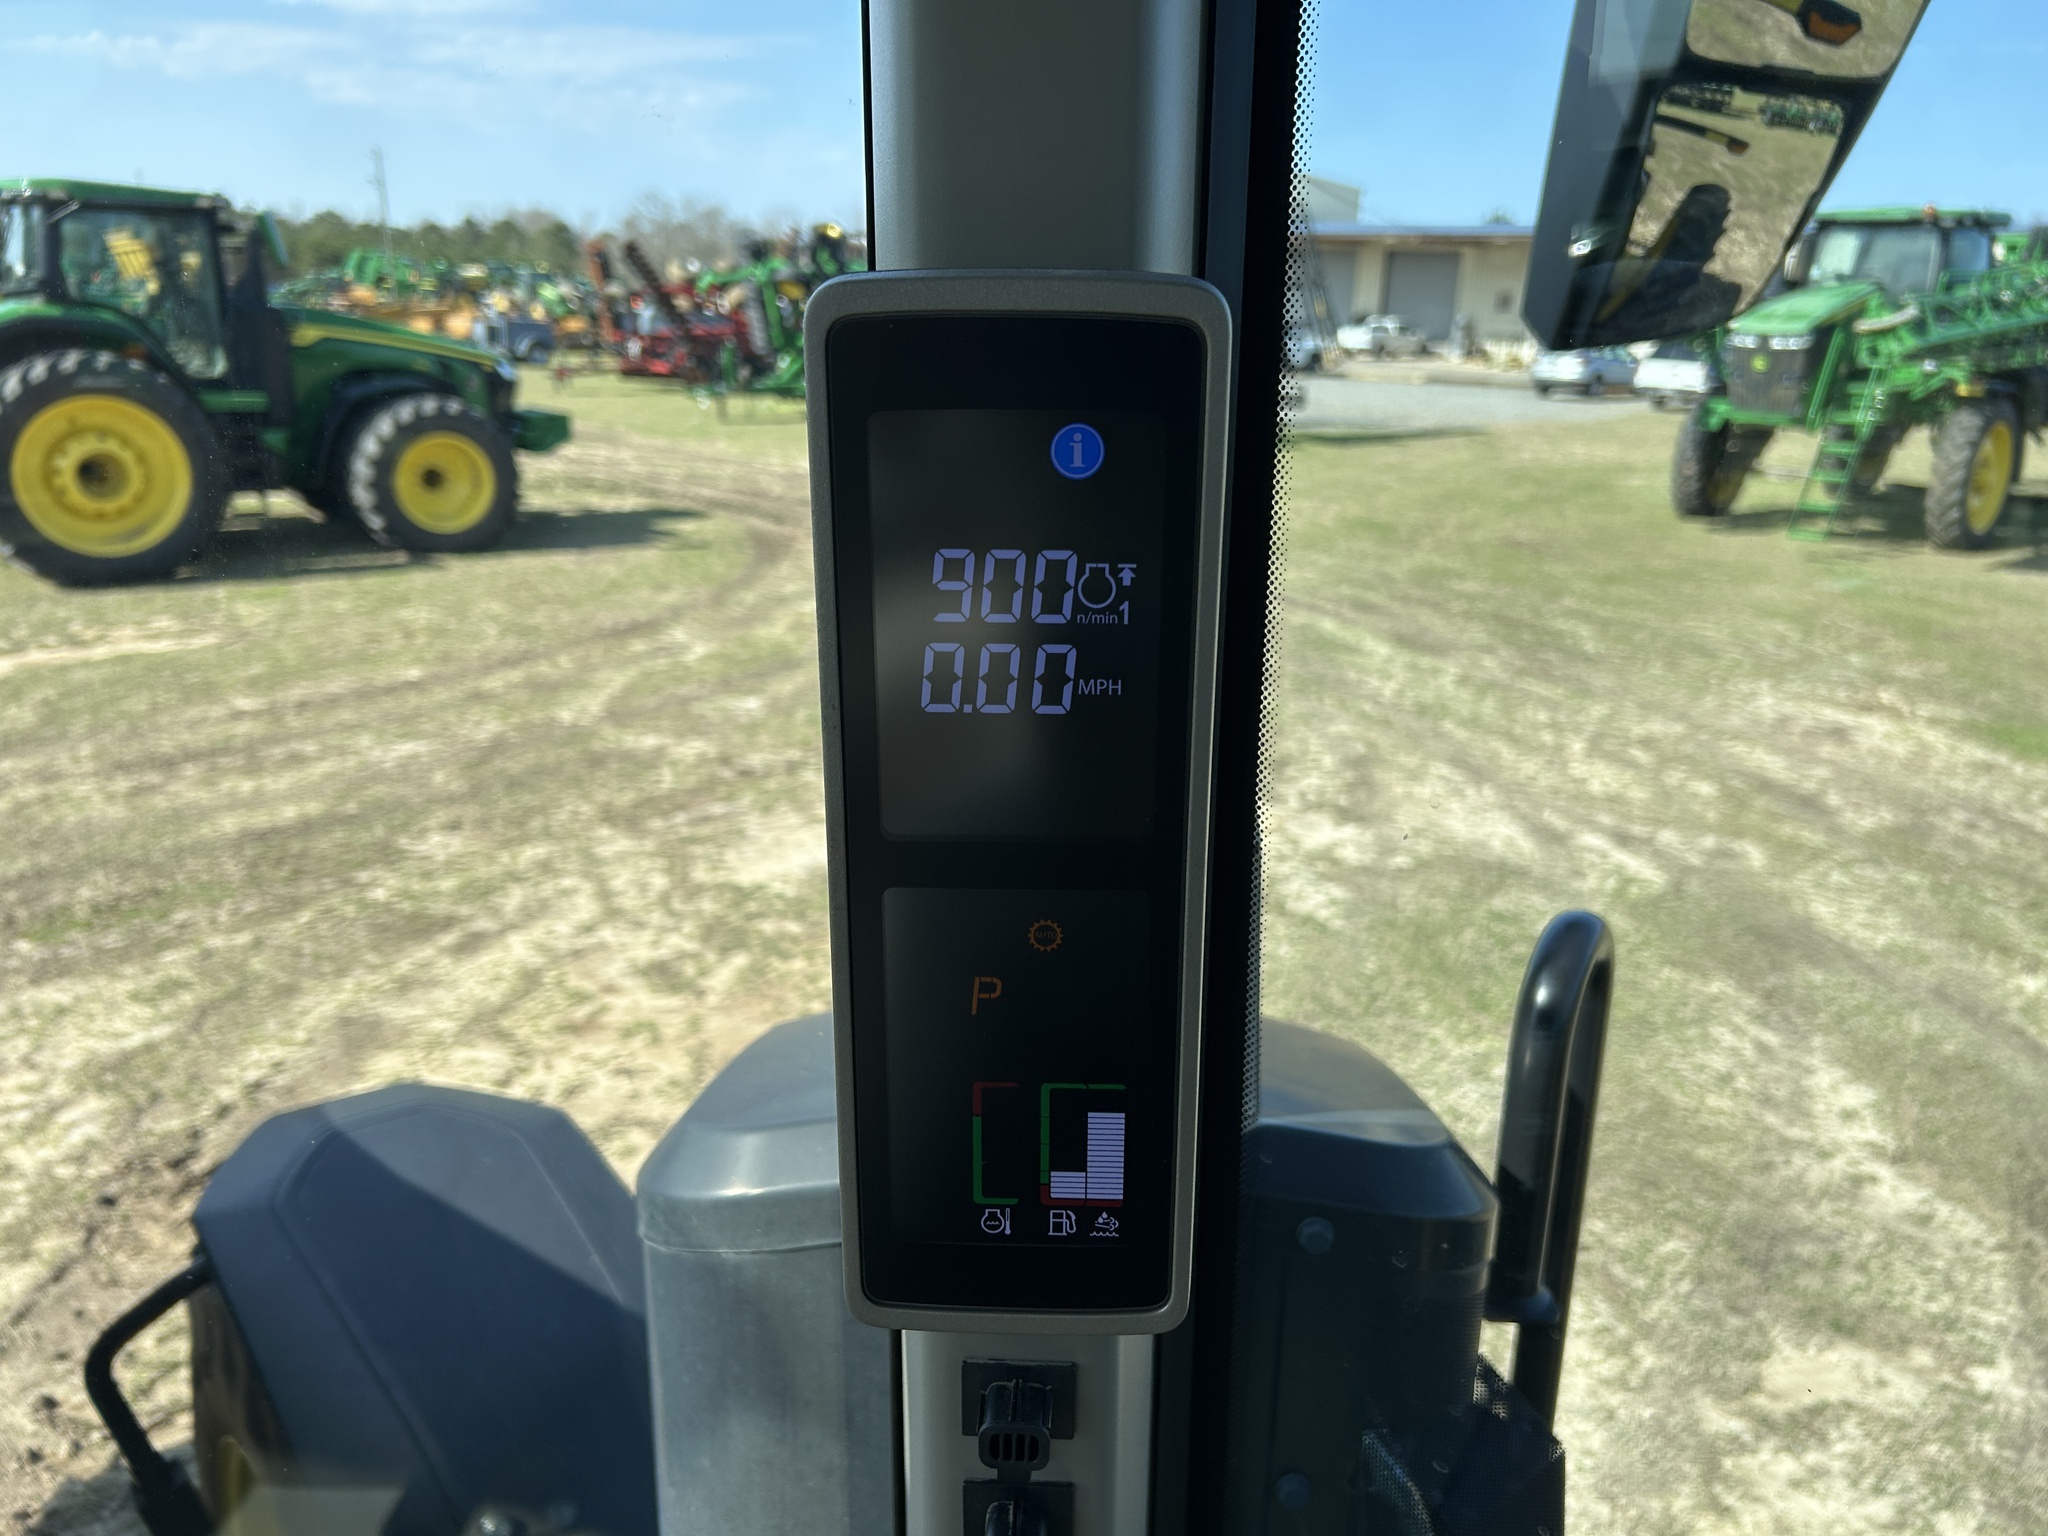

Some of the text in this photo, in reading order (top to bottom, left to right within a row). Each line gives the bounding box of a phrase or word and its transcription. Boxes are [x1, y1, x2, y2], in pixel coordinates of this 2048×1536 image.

[932, 548, 1130, 625] 900 n/min 1
[921, 642, 1122, 714] 0.00 MPH
[1034, 931, 1058, 940] AUTO
[971, 976, 1003, 1015] P
